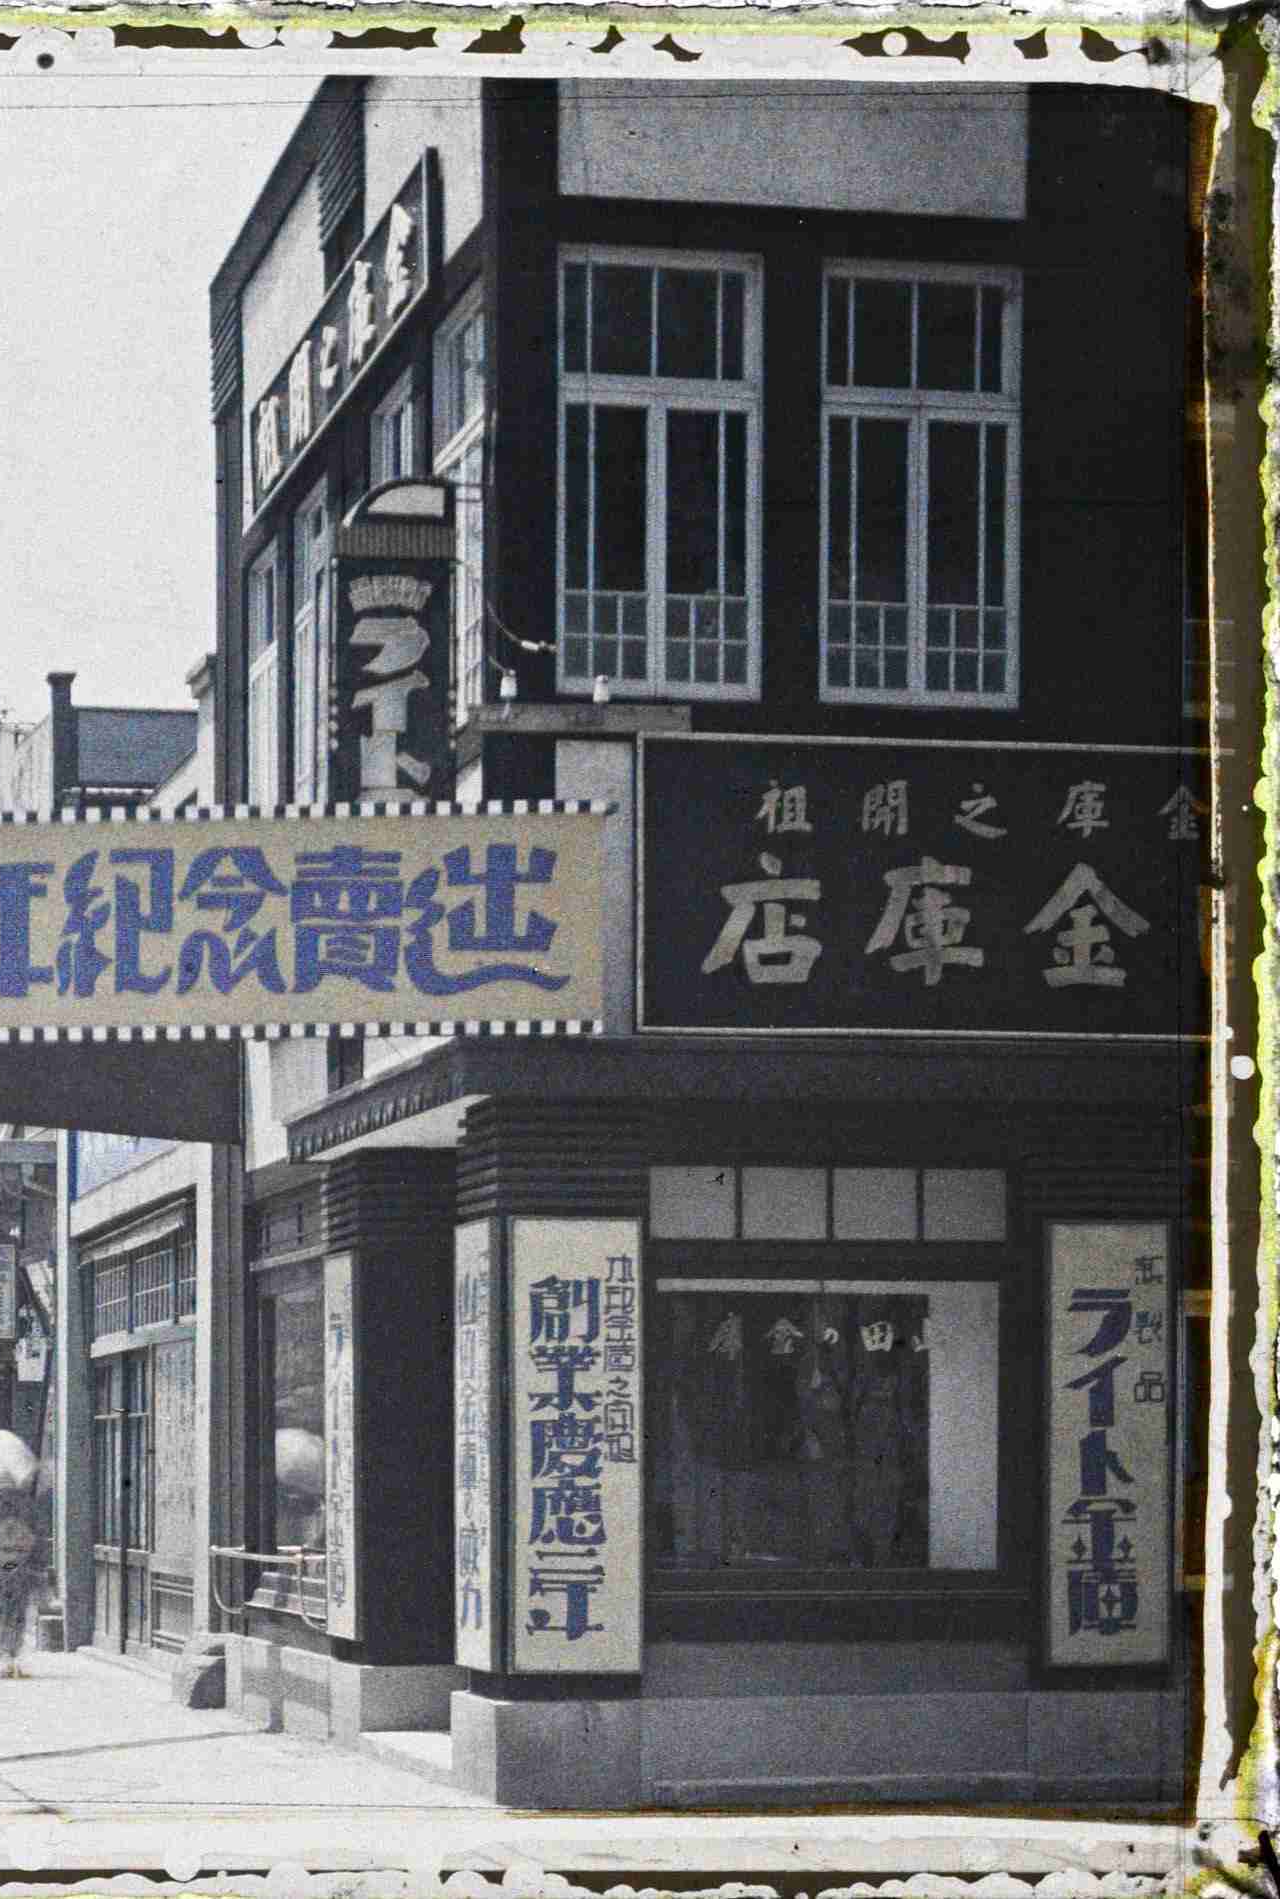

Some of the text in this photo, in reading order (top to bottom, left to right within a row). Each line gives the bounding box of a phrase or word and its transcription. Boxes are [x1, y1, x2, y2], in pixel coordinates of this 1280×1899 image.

[348, 573, 433, 801] ライト
[700, 850, 1151, 989] 金庫店
[1060, 1287, 1139, 1637] ライト金庫
